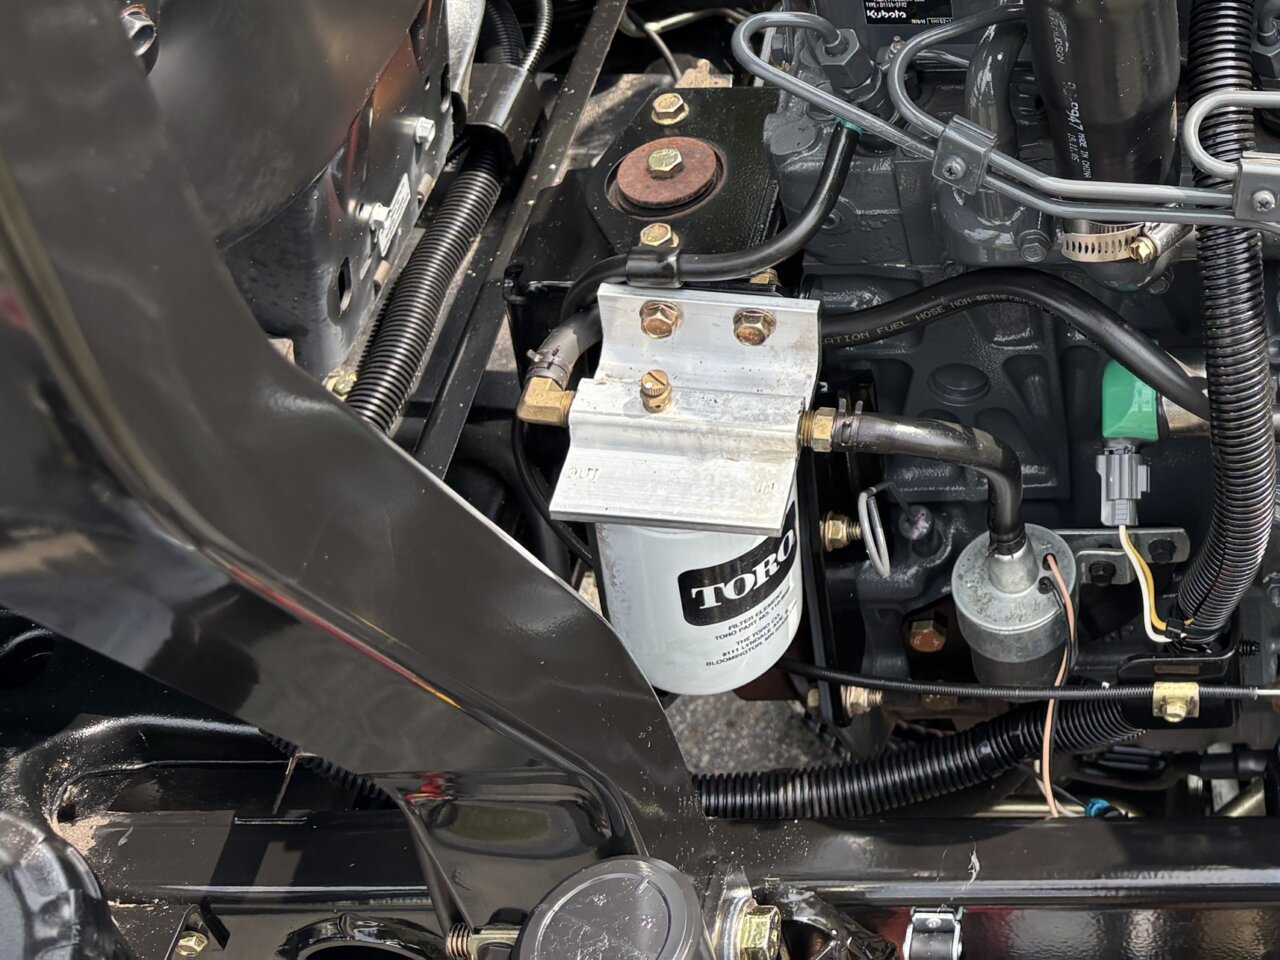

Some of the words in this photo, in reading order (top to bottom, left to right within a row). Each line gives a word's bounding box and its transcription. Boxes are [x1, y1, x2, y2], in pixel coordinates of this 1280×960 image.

[866, 9, 906, 18] Kubota
[1077, 132, 1088, 149] MADE
[1082, 160, 1092, 179] CHINA
[822, 330, 870, 345] ATION
[876, 319, 911, 335] FUEL
[915, 305, 946, 322] HOSE
[691, 529, 796, 610] TORO
[728, 616, 754, 630] FILTER
[755, 590, 783, 617] ELEMENT
[714, 630, 738, 640] TORO
[738, 619, 758, 633] PART
[758, 611, 770, 622] NO.
[736, 634, 752, 646] THE
[752, 623, 770, 638] TORO
[722, 647, 740, 658] 8111
[741, 628, 772, 650] LYNDALE
